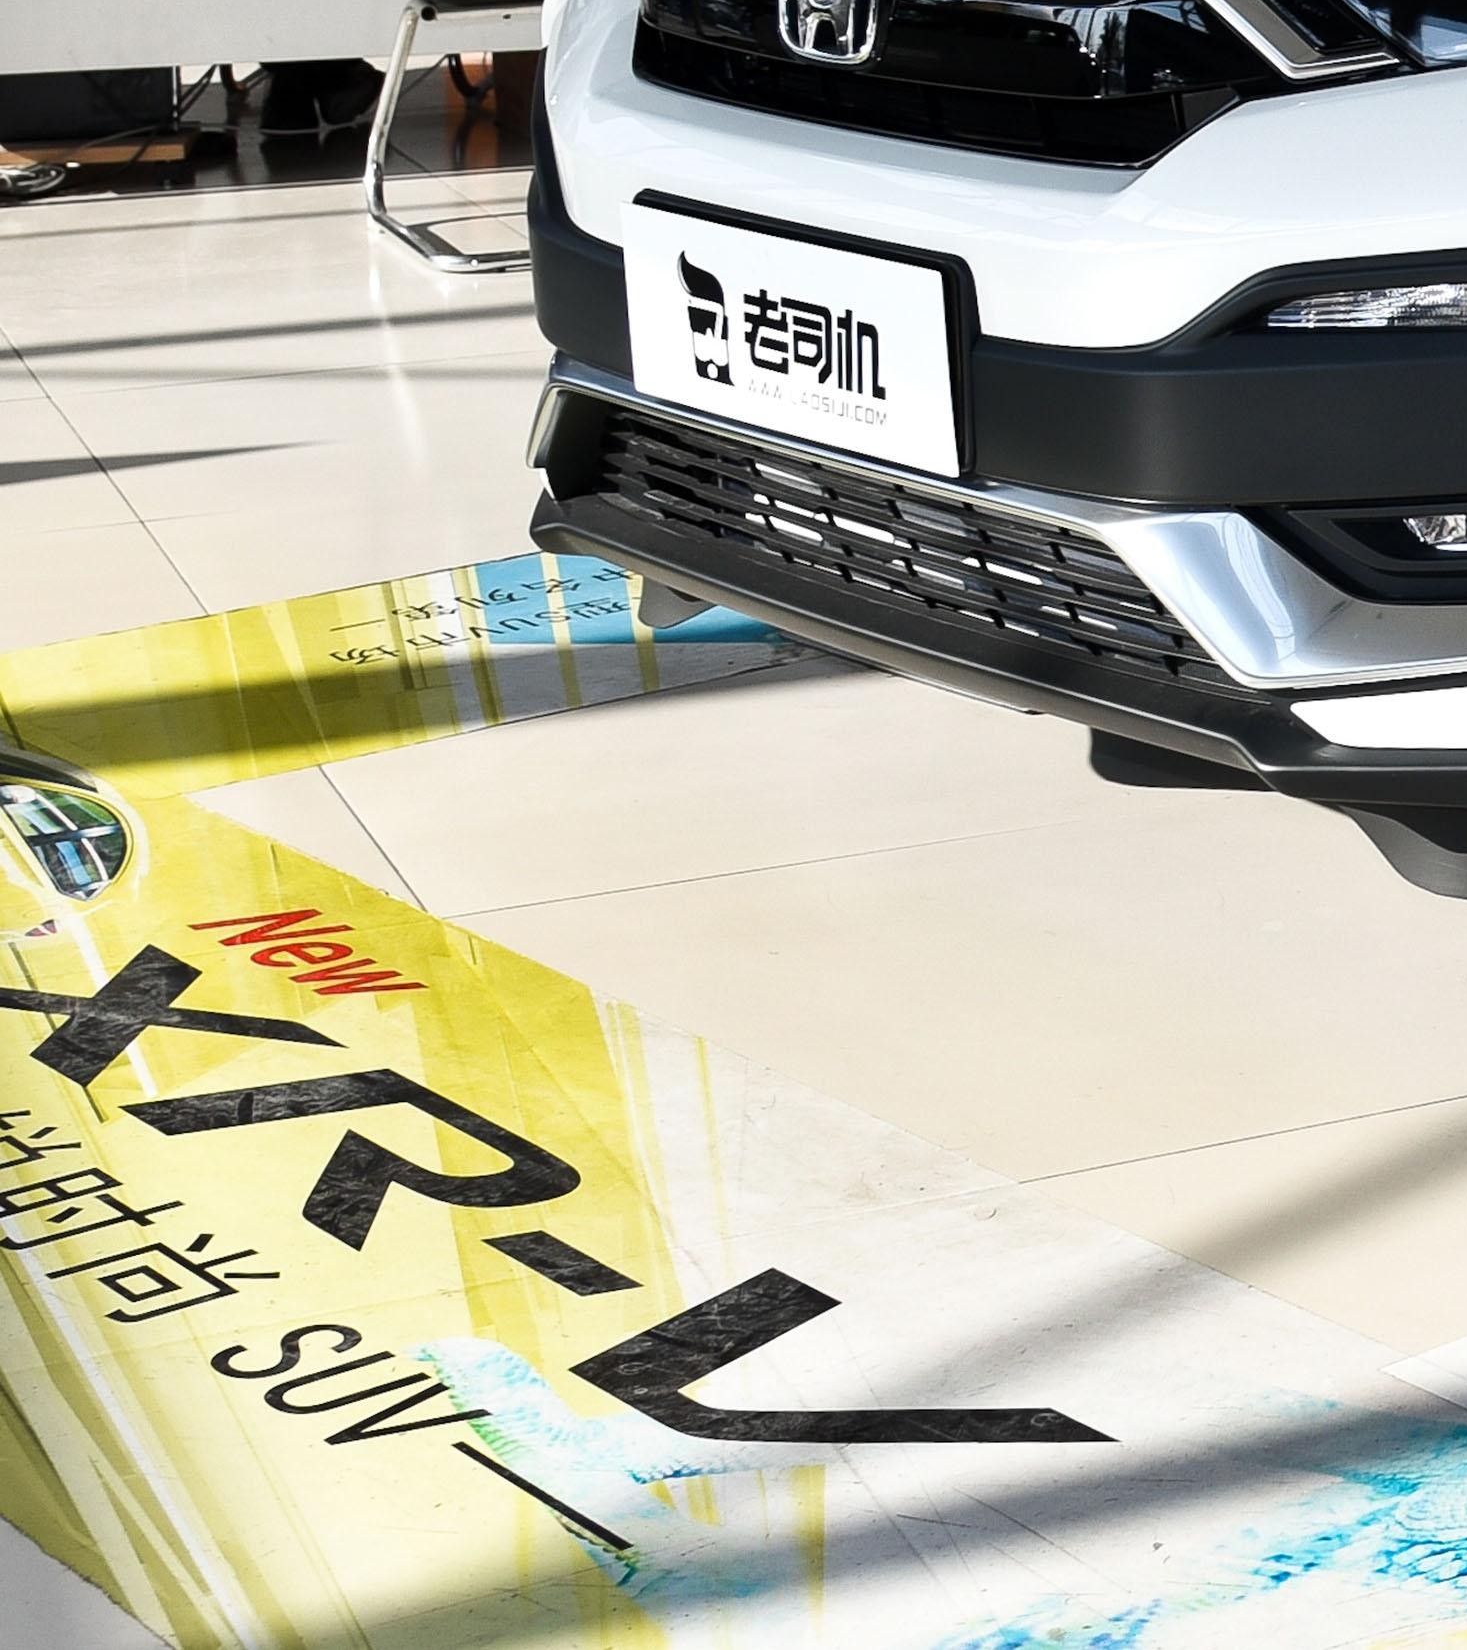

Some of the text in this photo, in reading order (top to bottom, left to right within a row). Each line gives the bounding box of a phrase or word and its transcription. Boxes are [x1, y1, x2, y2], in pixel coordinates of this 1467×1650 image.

[742, 288, 887, 401] 老司机
[190, 904, 427, 998] New
[0, 944, 1122, 1444] XR-V
[210, 1320, 470, 1448] SUV
